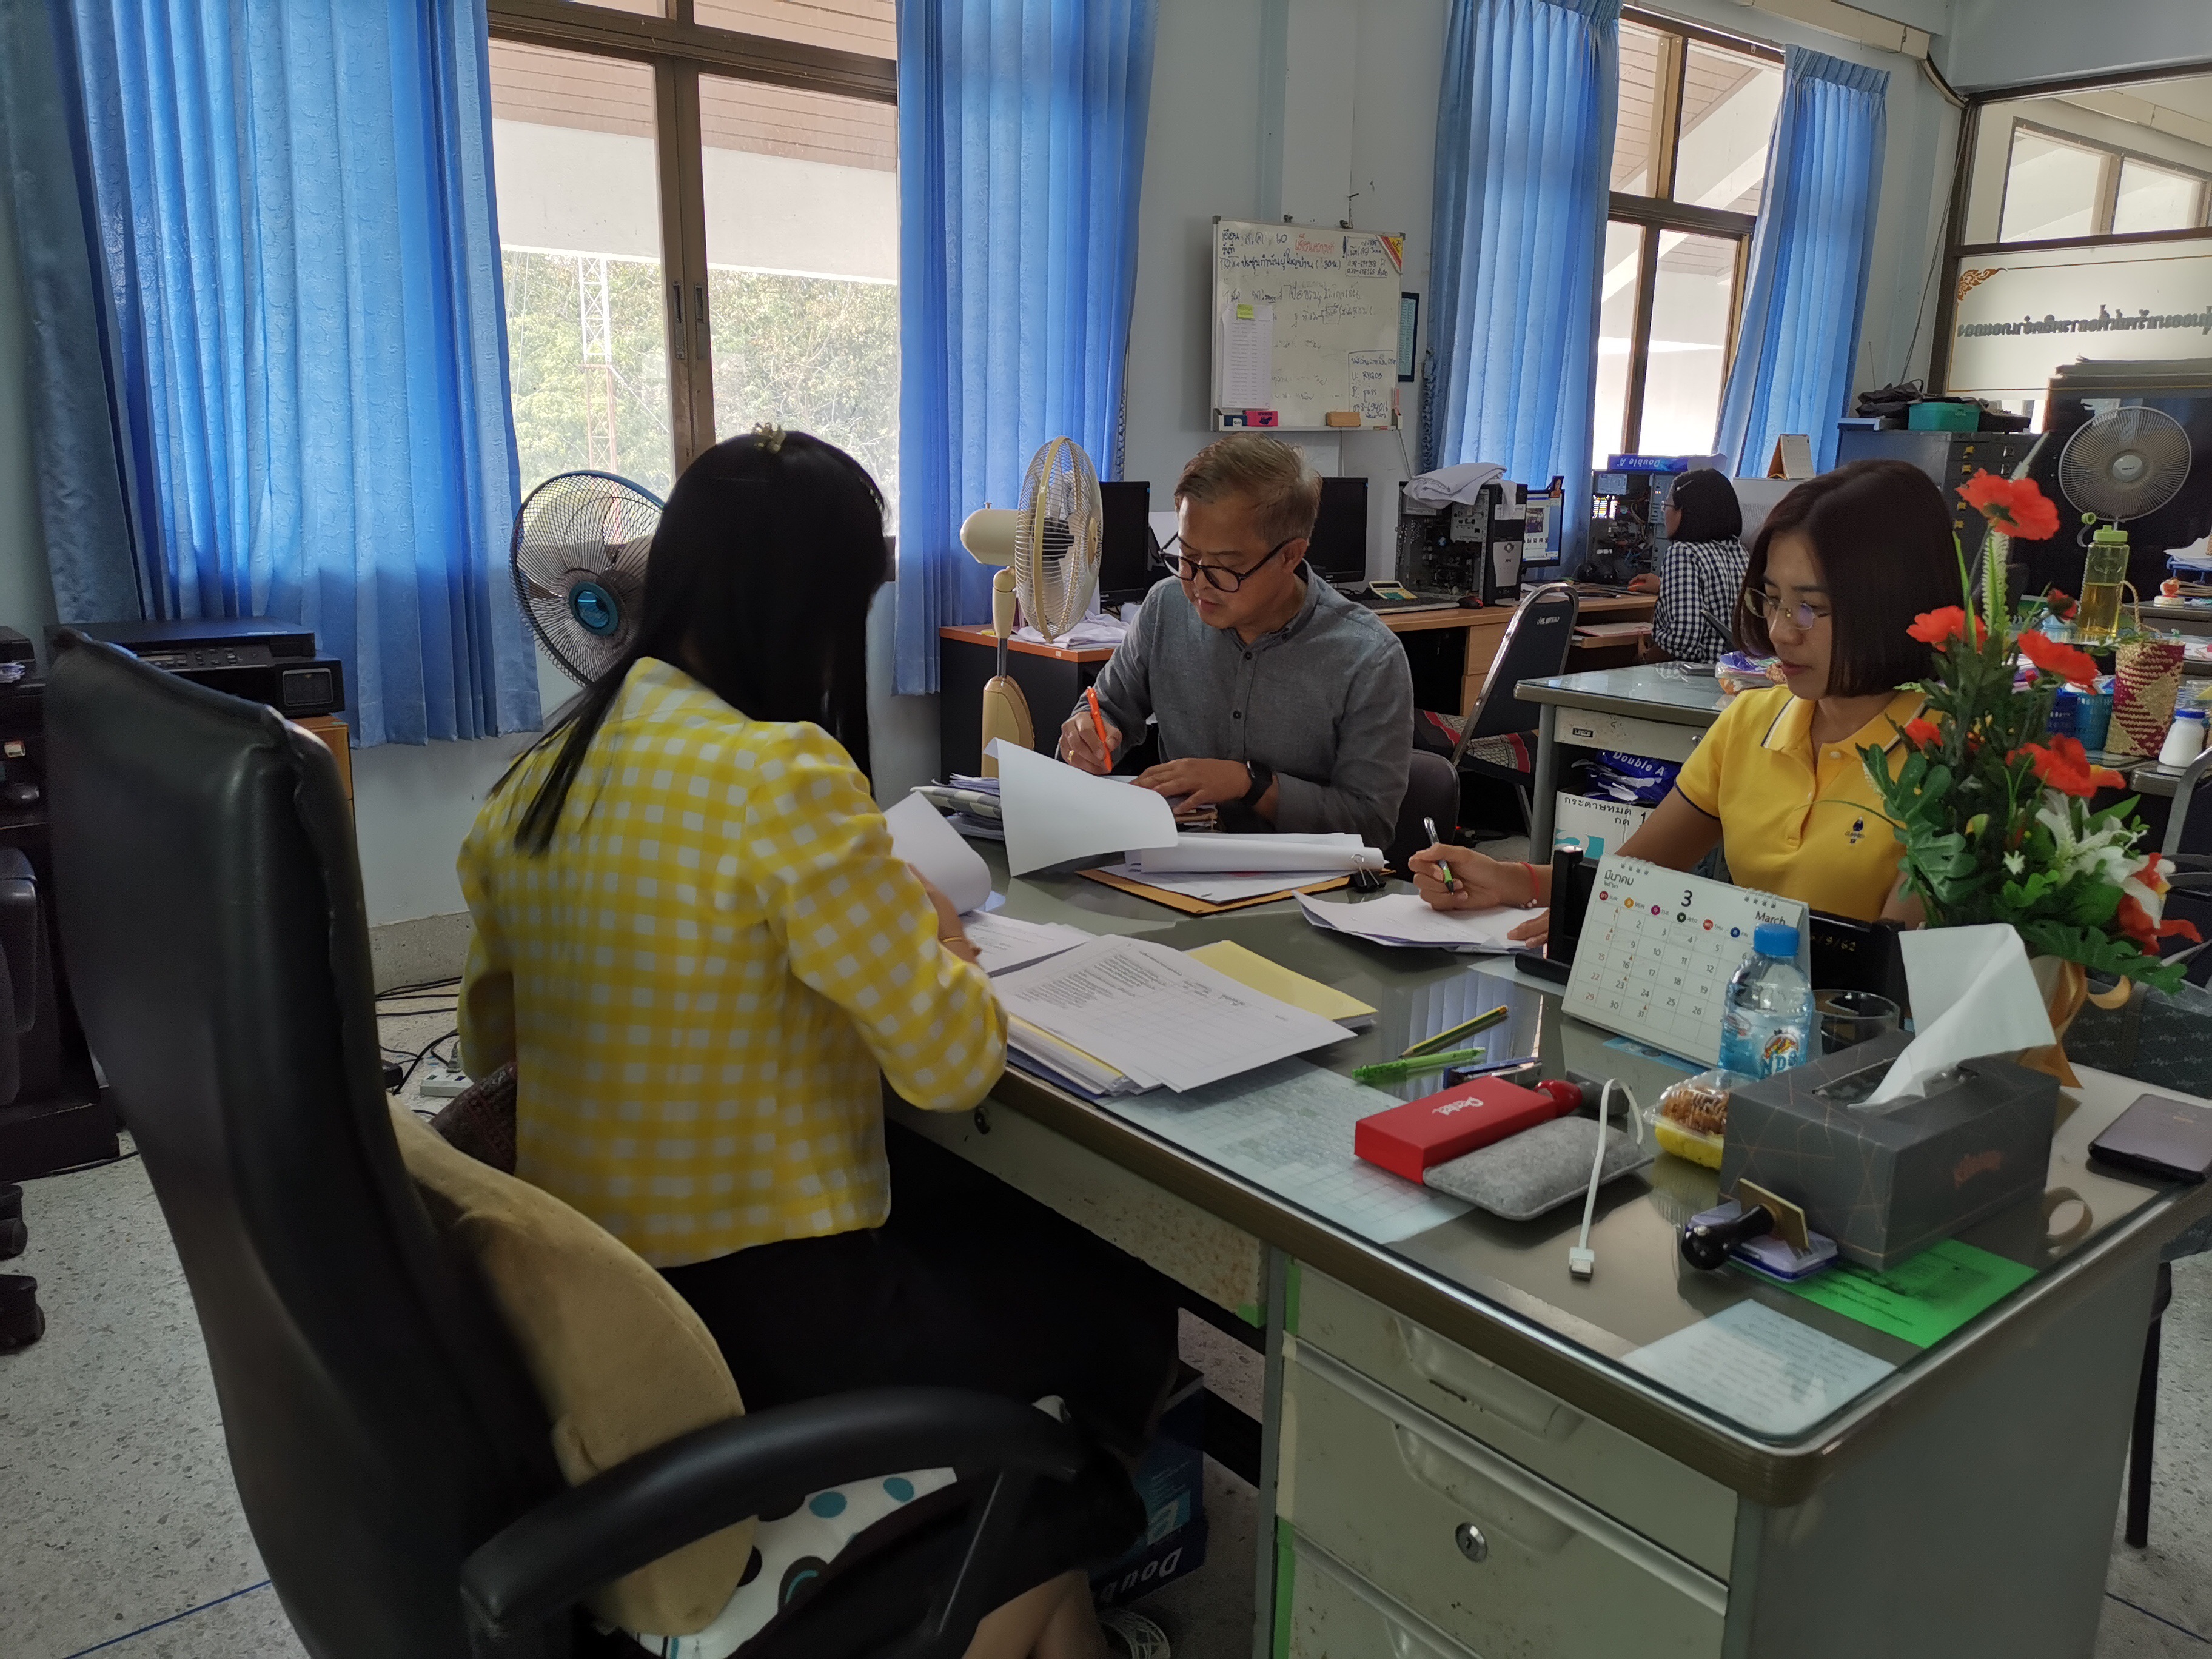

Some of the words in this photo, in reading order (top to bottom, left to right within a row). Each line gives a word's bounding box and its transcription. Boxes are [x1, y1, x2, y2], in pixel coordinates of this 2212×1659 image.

[1629, 458, 1661, 468] Double
[1612, 751, 1653, 772] Double
[1655, 766, 1664, 777] A
[1564, 796, 1632, 816] กระดาษหมด
[1614, 817, 1630, 826] กด
[1604, 869, 1634, 886] มีนาคม
[1680, 889, 1693, 907] 3
[1755, 910, 1786, 925] March
[1653, 948, 1661, 956] 10
[1706, 964, 1714, 973] 12
[1598, 953, 1606, 961] 15
[1623, 960, 1629, 969] 16
[1649, 968, 1656, 977] 17
[1674, 977, 1681, 985] 18
[1700, 985, 1708, 994] 19
[1585, 992, 1595, 1001] 29
[1609, 1000, 1619, 1010] 30
[1590, 972, 1600, 981] 22
[1615, 980, 1624, 990] 23
[1640, 988, 1649, 997] 24
[1666, 997, 1675, 1007] 25
[1692, 1005, 1702, 1015] 26
[1099, 1546, 1183, 1604] Doub
